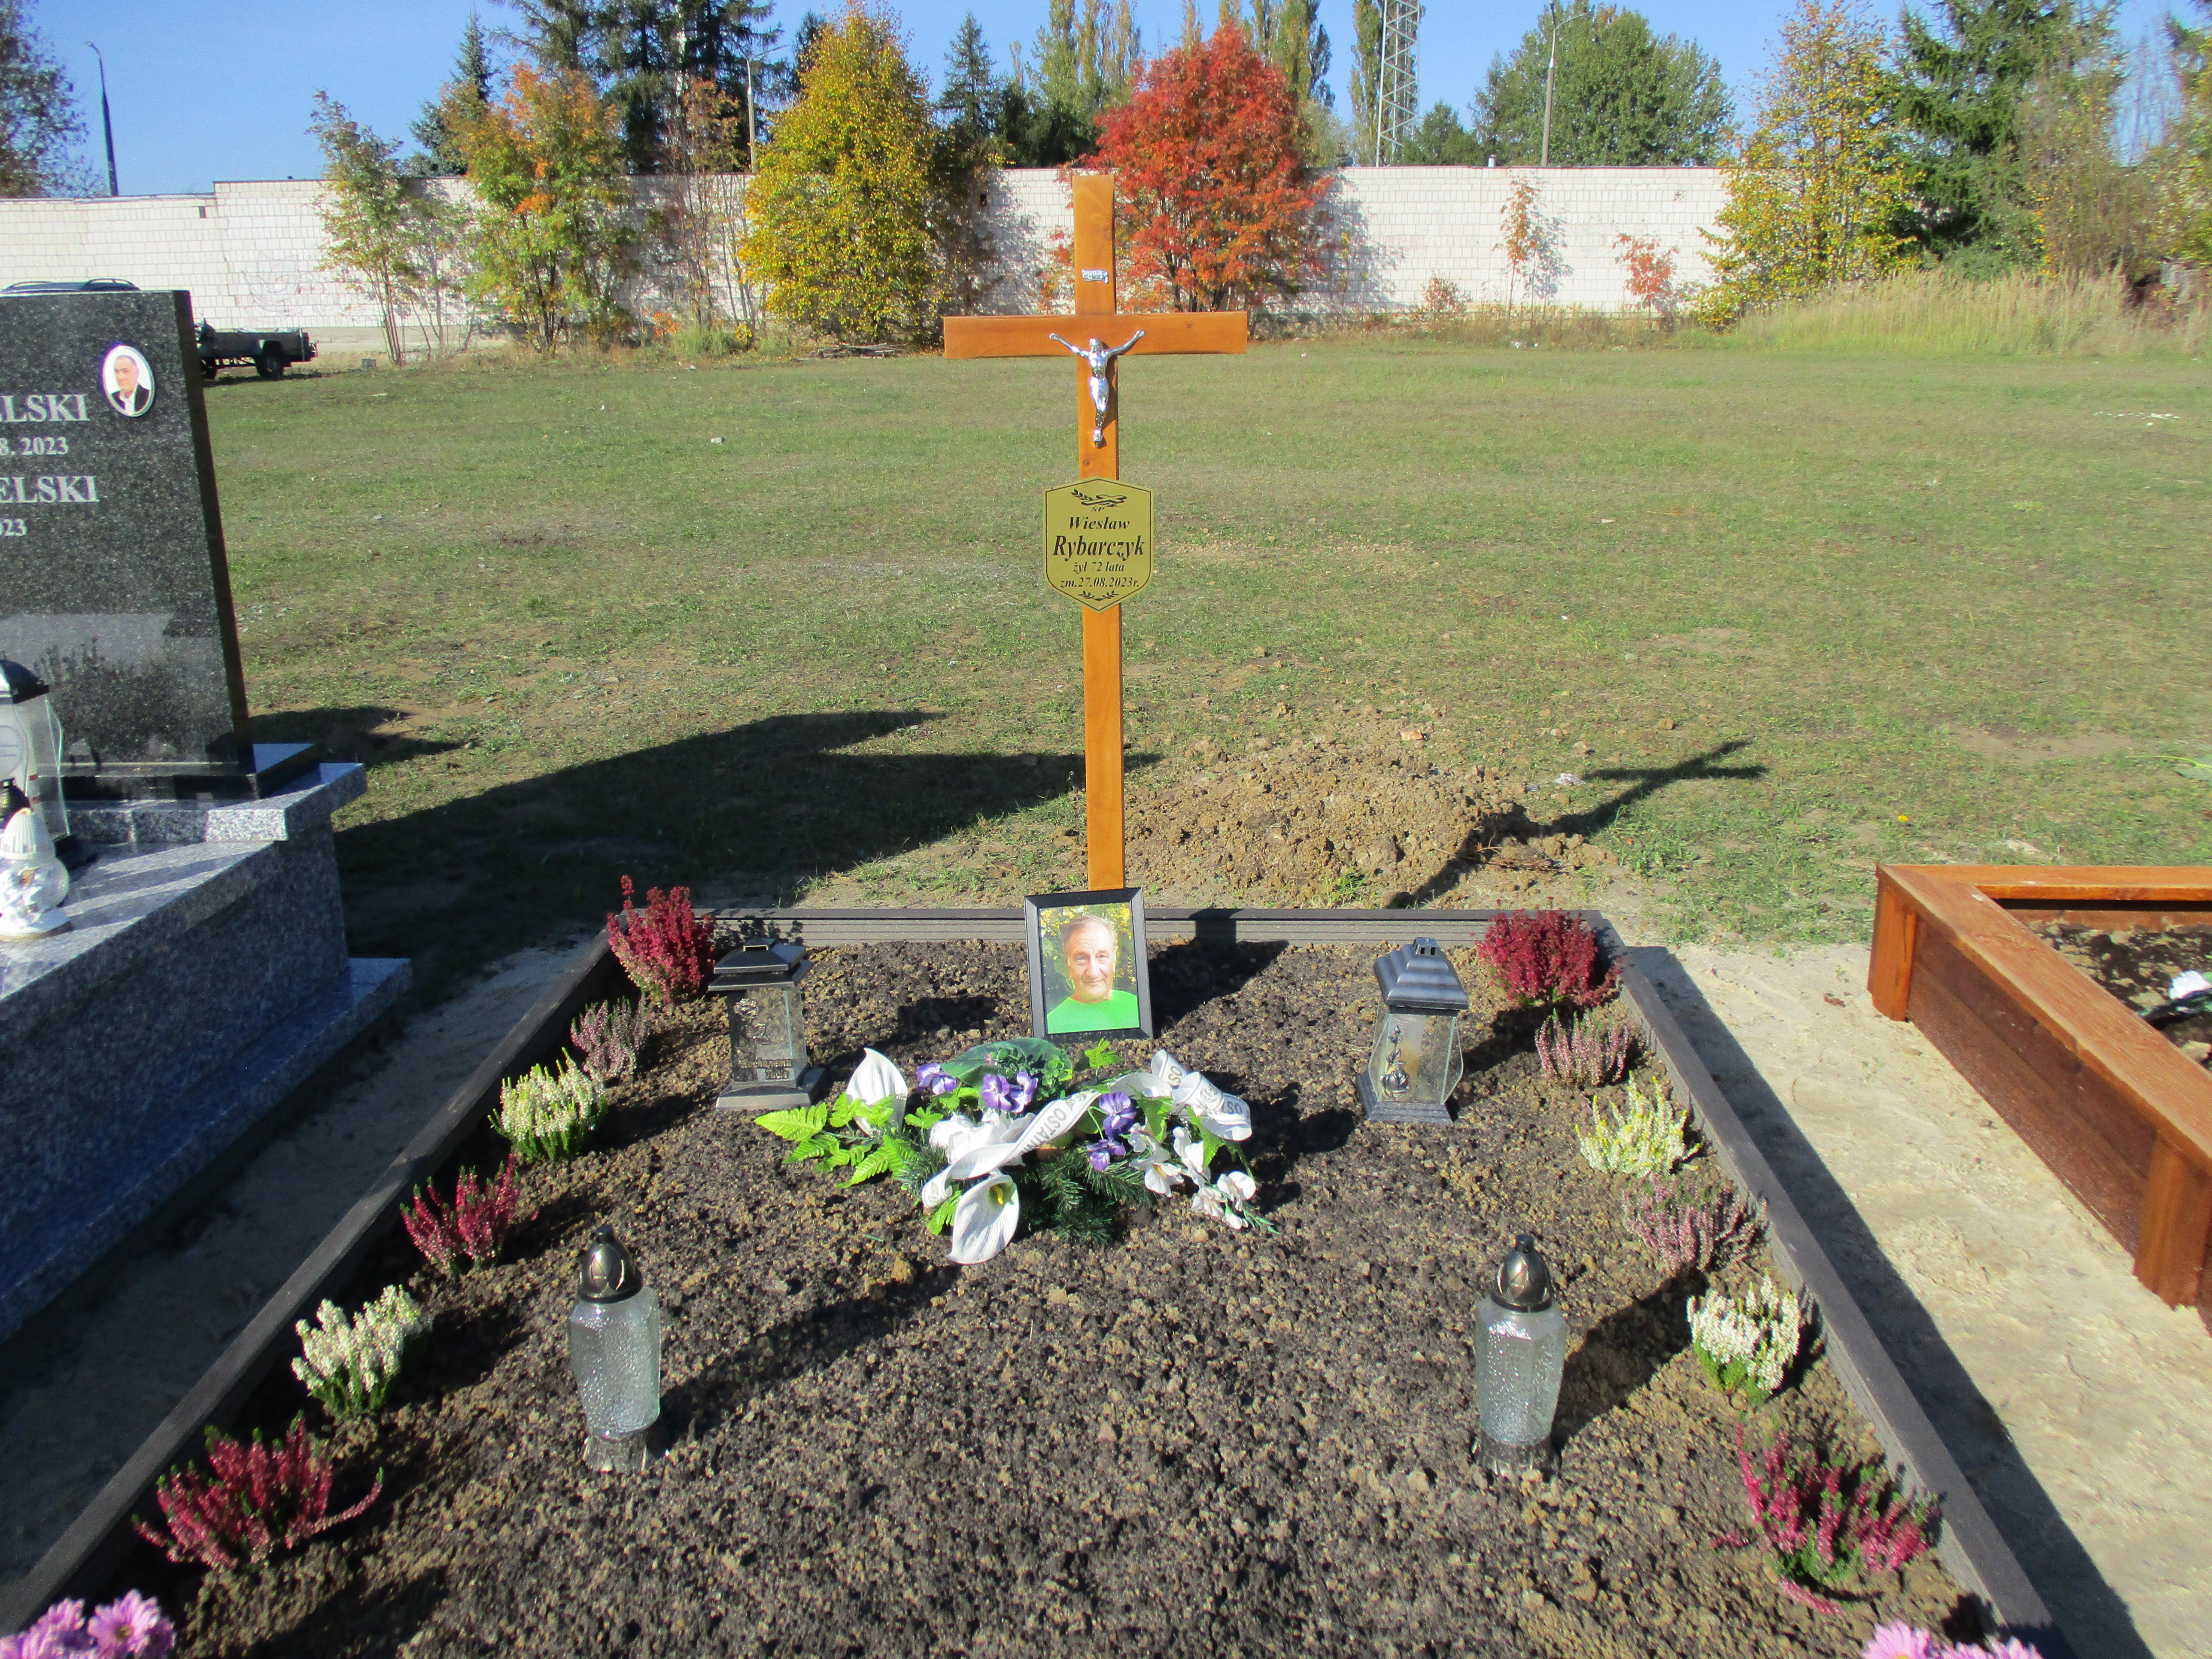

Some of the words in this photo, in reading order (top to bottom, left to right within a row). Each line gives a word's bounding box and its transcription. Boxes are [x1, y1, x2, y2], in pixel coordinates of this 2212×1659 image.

[0, 394, 90, 422] LSKI
[20, 436, 70, 456] 2023
[0, 518, 27, 537] 23
[1069, 516, 1130, 529] Wiesław
[1052, 535, 1145, 562] Rybarczyk
[1091, 561, 1103, 571] 72
[1105, 562, 1125, 572] lata
[1060, 577, 1139, 588] zm.27.08.2023r.
